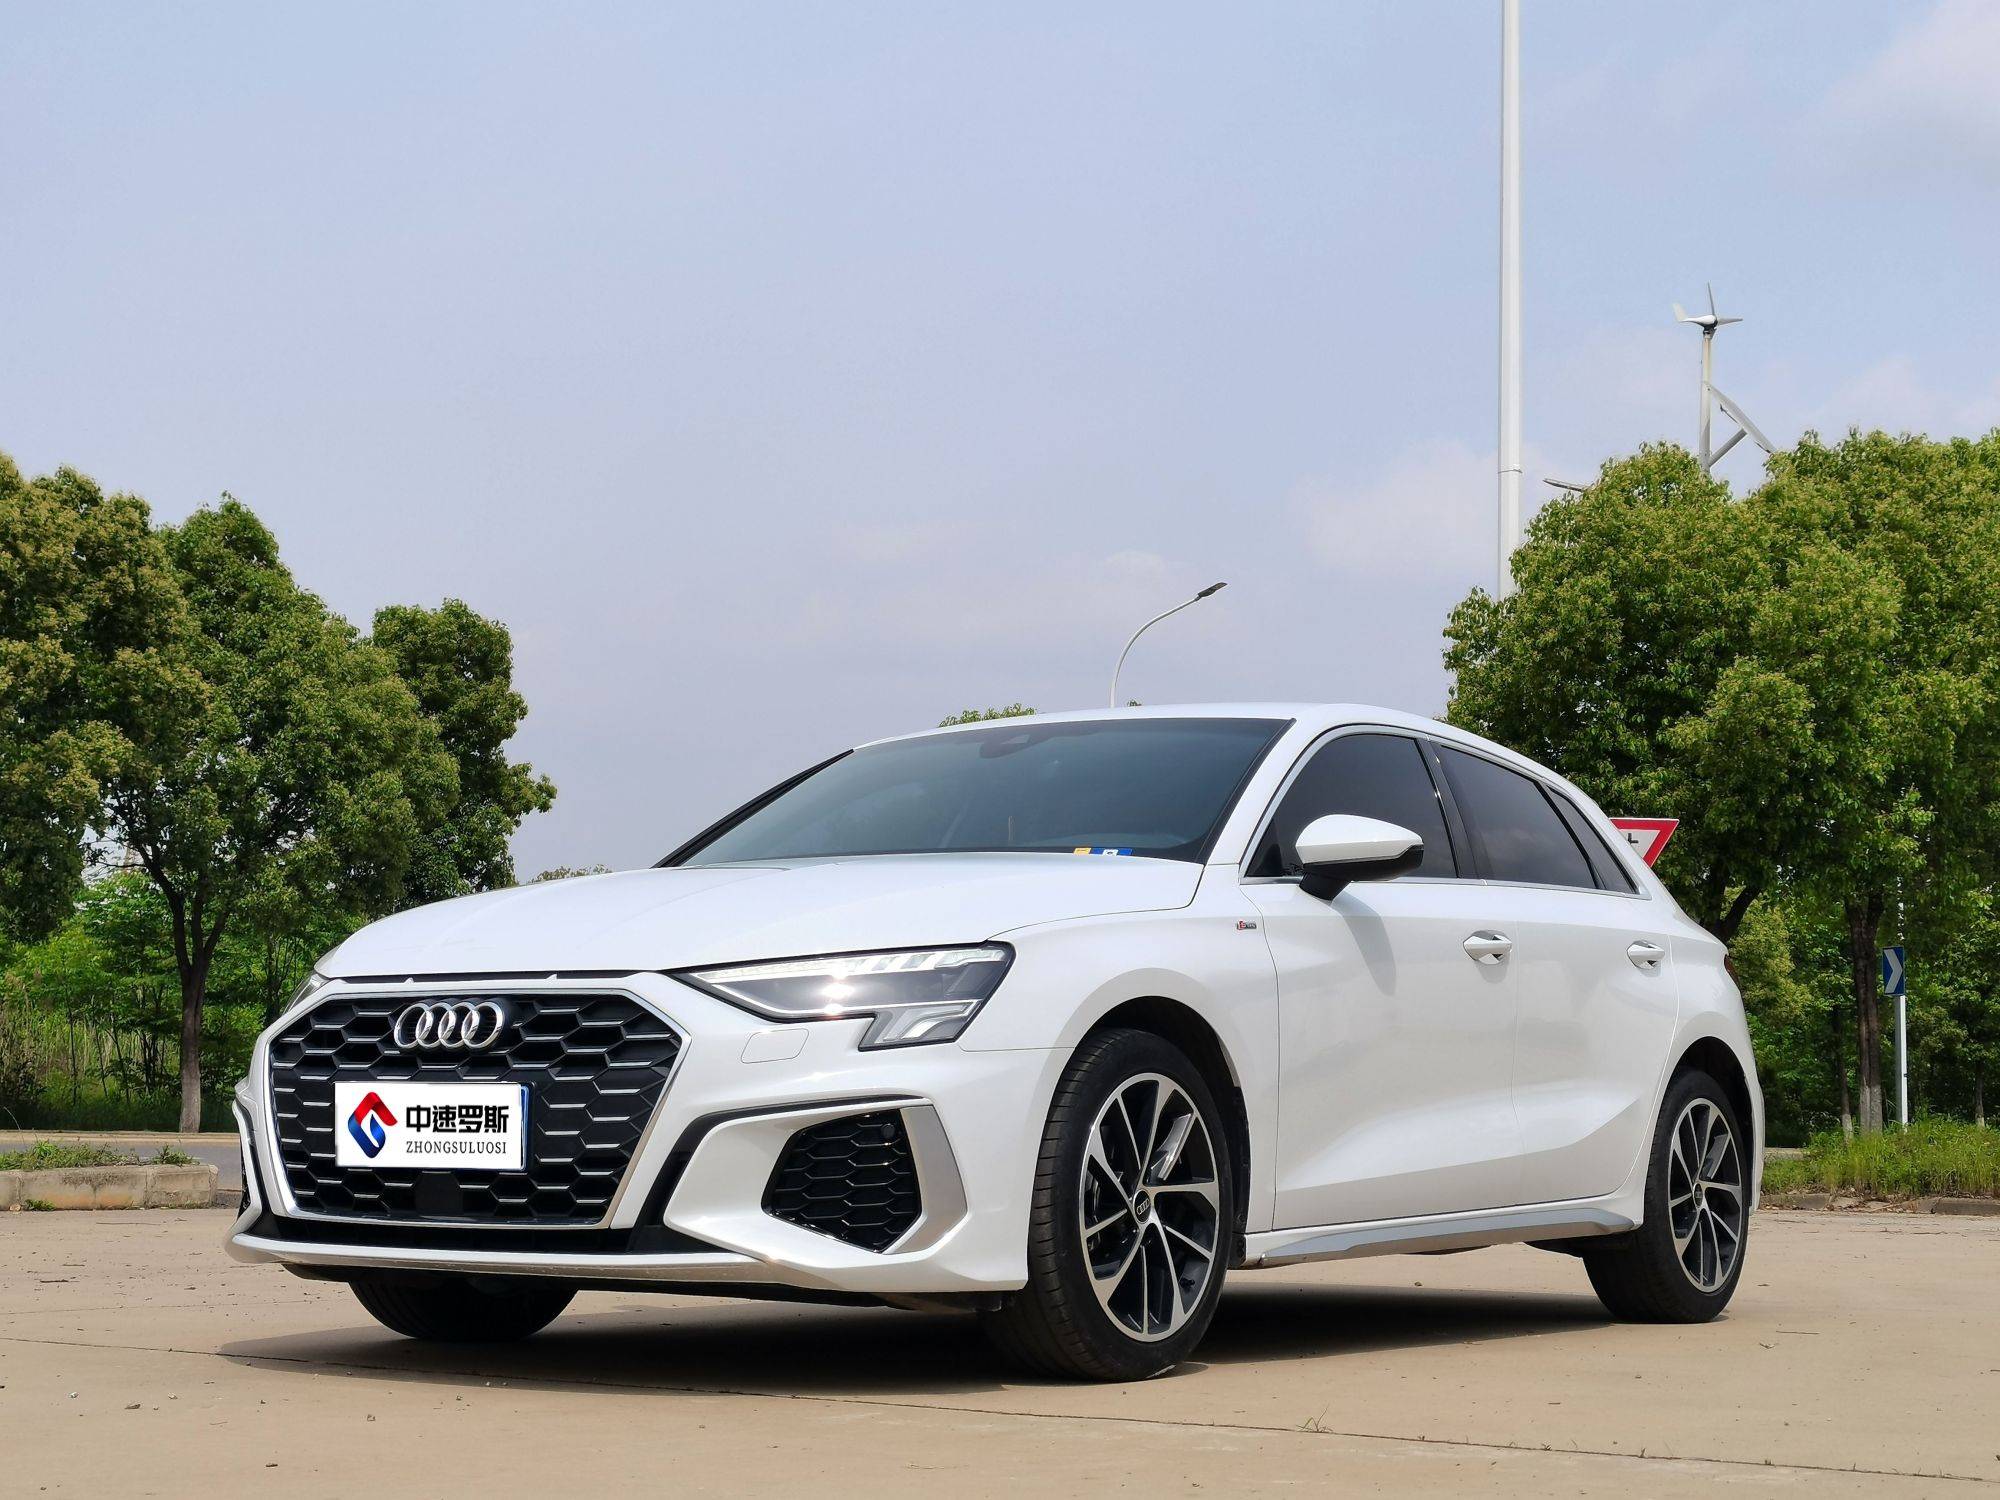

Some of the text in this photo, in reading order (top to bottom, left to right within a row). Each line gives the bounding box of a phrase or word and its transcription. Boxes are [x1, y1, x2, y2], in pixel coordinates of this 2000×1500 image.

[406, 1105, 509, 1133] 中速罗斯
[406, 1141, 507, 1154] ZHONGSULUOSI
